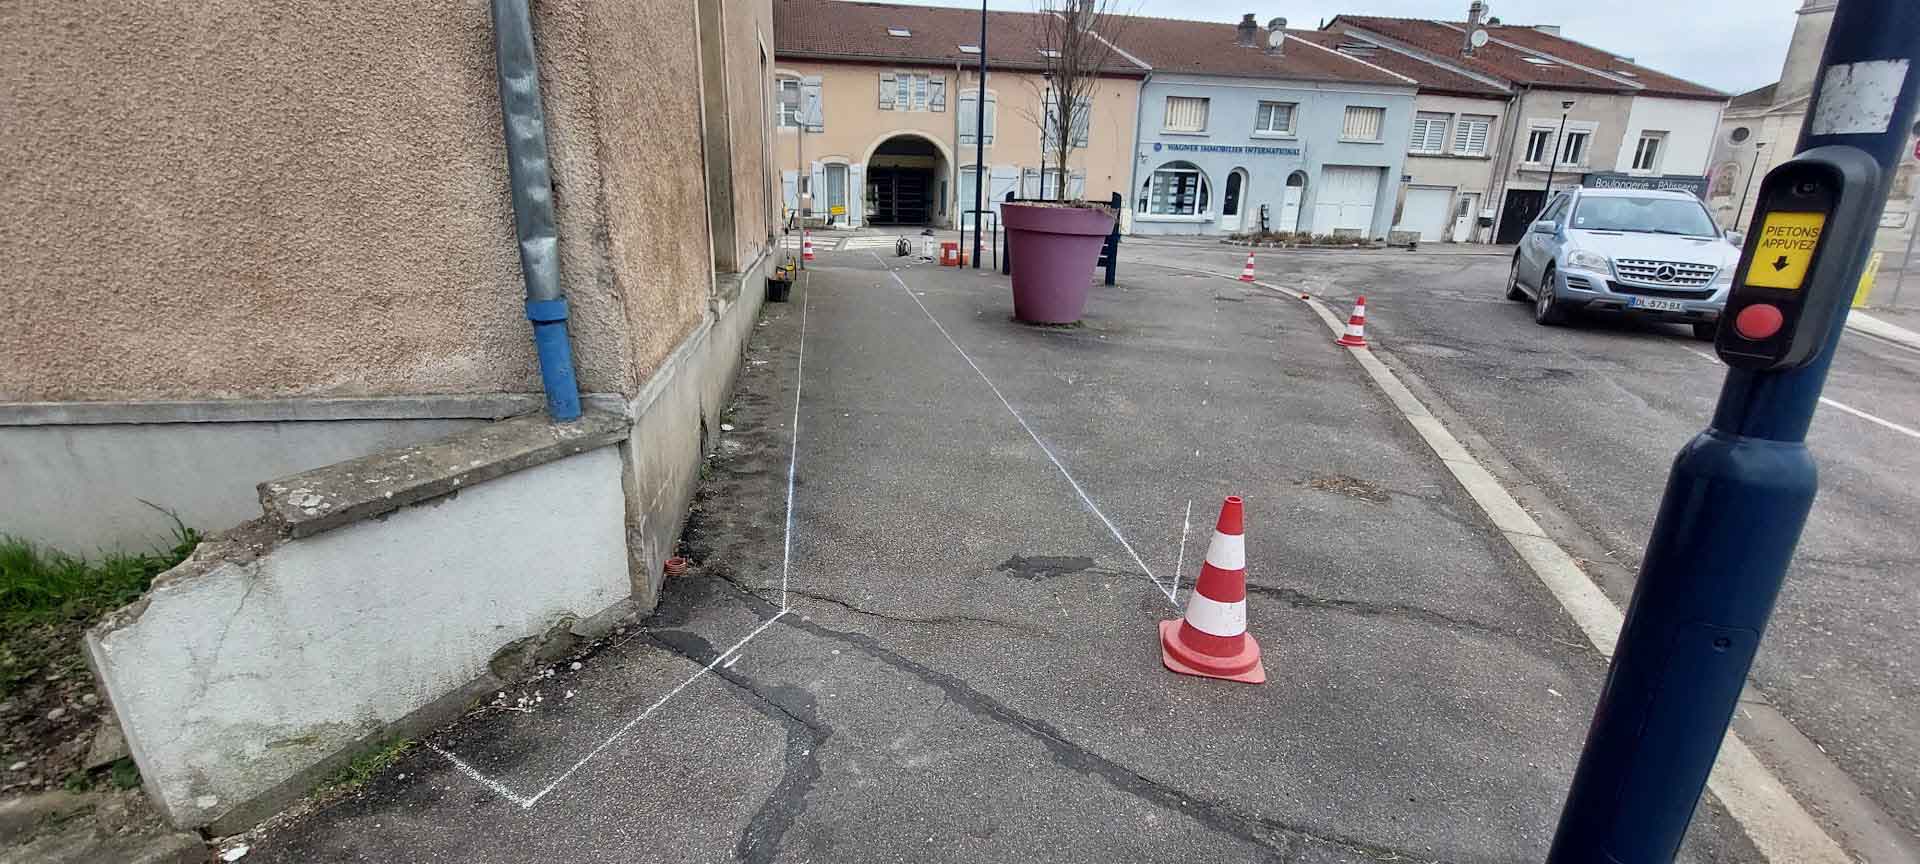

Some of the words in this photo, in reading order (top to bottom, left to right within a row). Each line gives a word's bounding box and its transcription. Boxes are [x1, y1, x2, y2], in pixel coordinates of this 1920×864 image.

[1167, 143, 1199, 151] WAGNER
[1766, 226, 1820, 238] PIETONS
[1761, 239, 1816, 250] APPUYEZ
